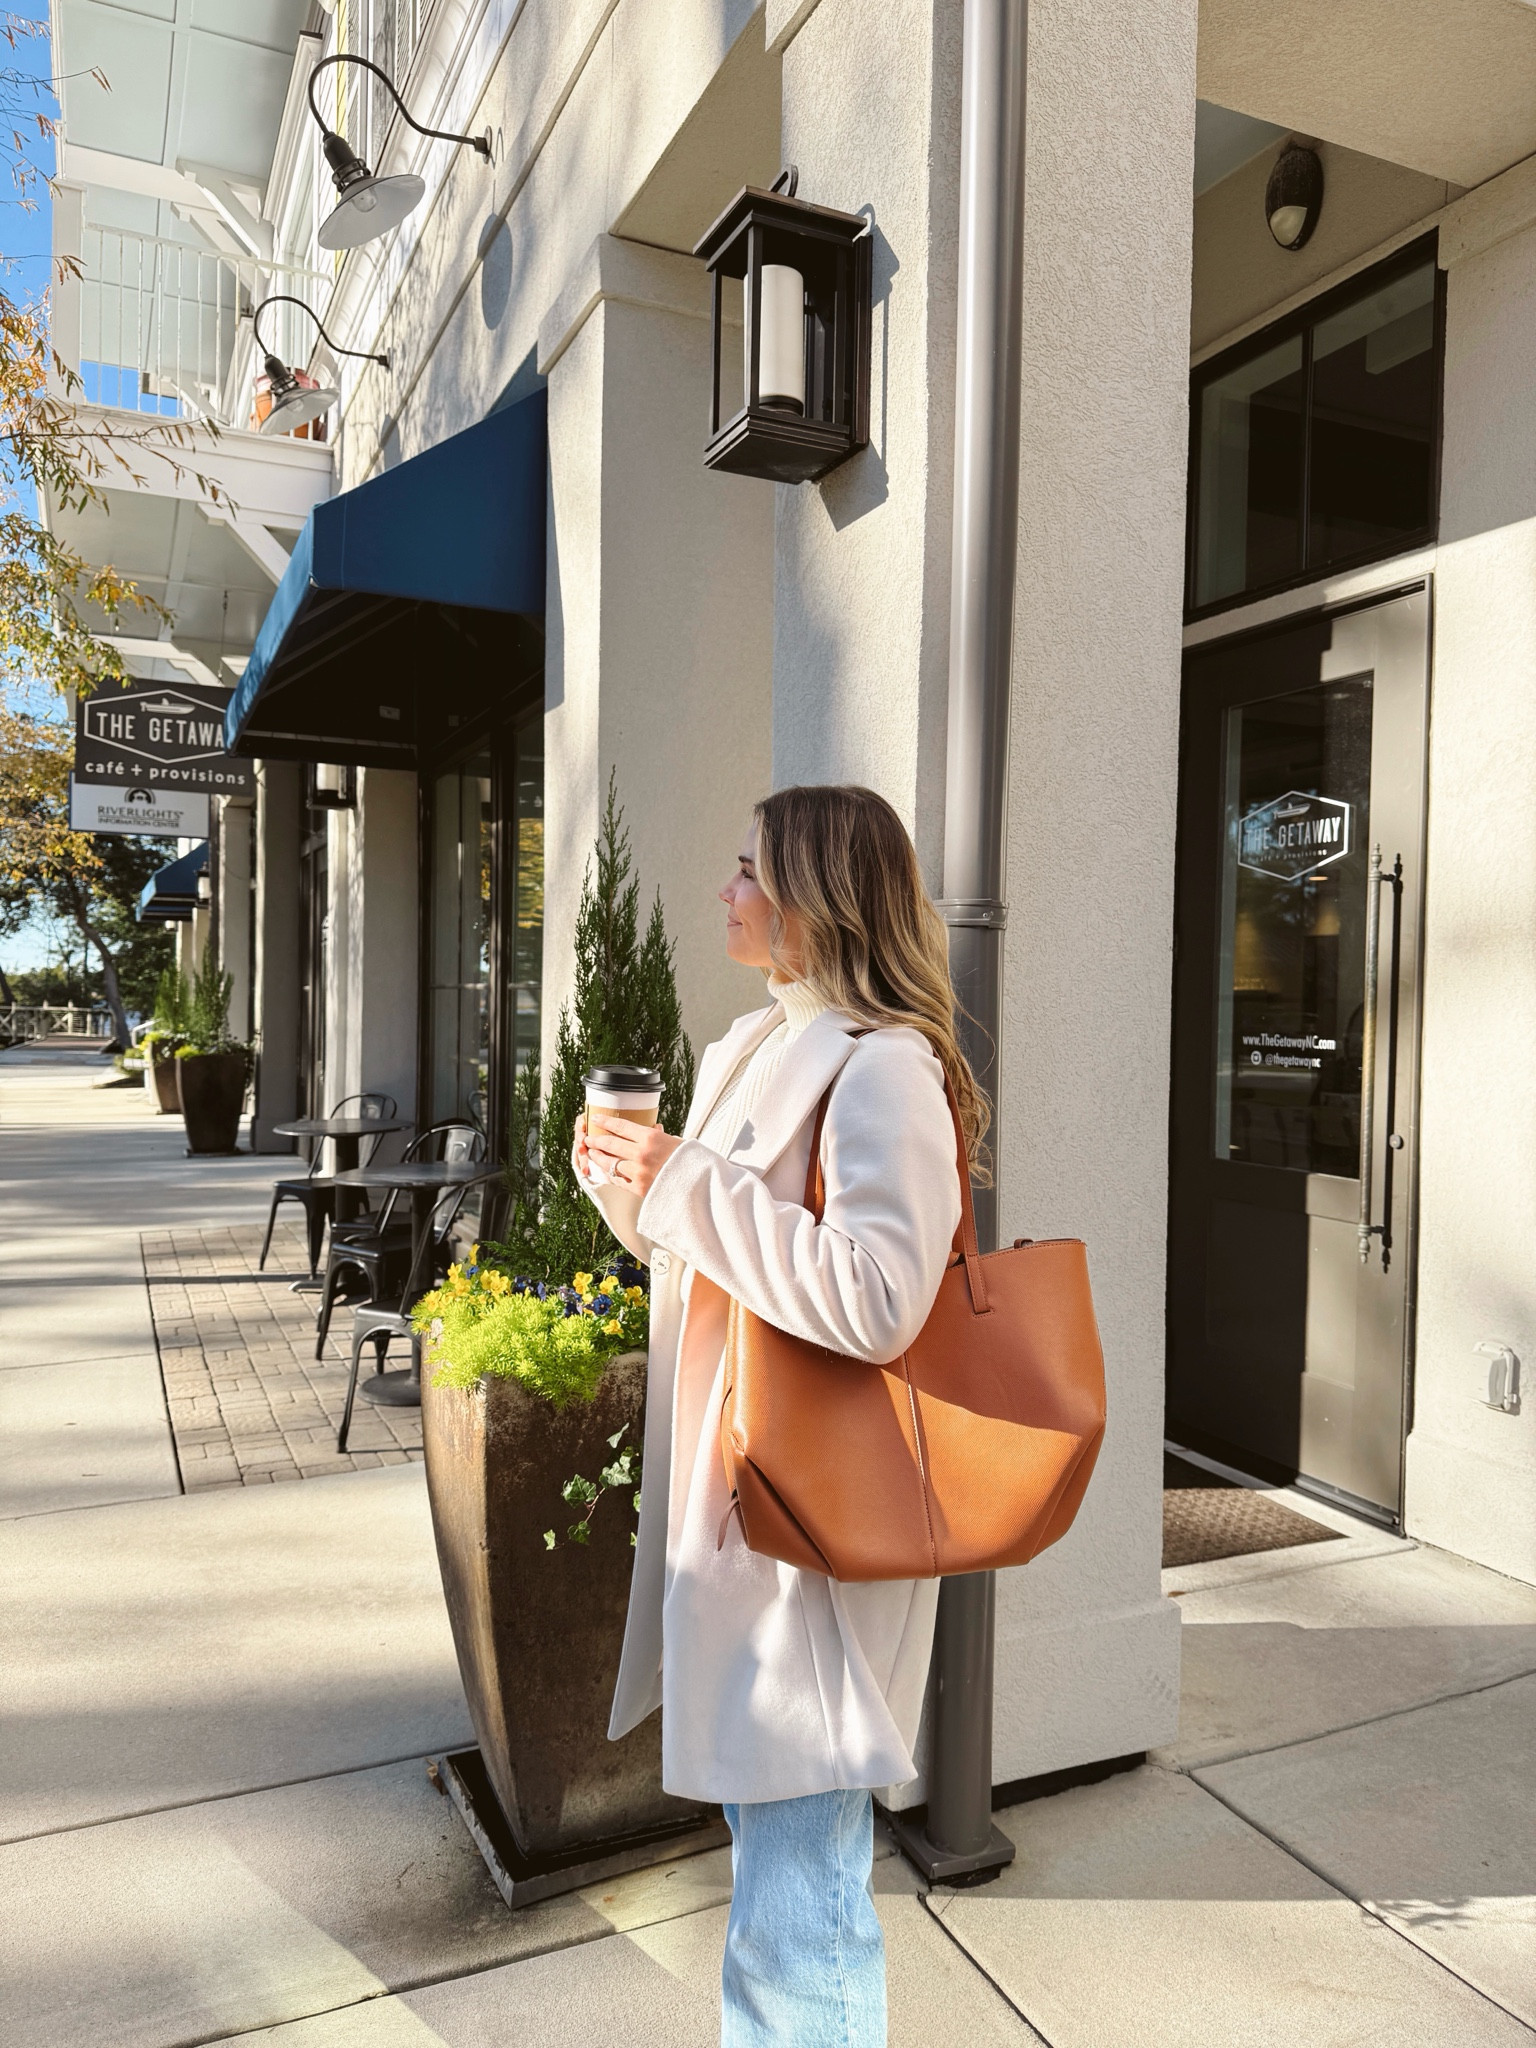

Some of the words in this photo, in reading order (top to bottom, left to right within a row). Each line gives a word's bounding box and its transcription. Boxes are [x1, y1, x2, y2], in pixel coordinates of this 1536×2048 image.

[96, 712, 136, 740] THE
[149, 717, 225, 748] GETAWA
[85, 761, 125, 775] café
[150, 767, 246, 785] provisions
[1245, 827, 1271, 850] THE
[1278, 816, 1341, 847] GETAWAY
[1242, 1033, 1336, 1051] www.TheGetawayNC.com
[1265, 1052, 1321, 1069] @thegetawaync
